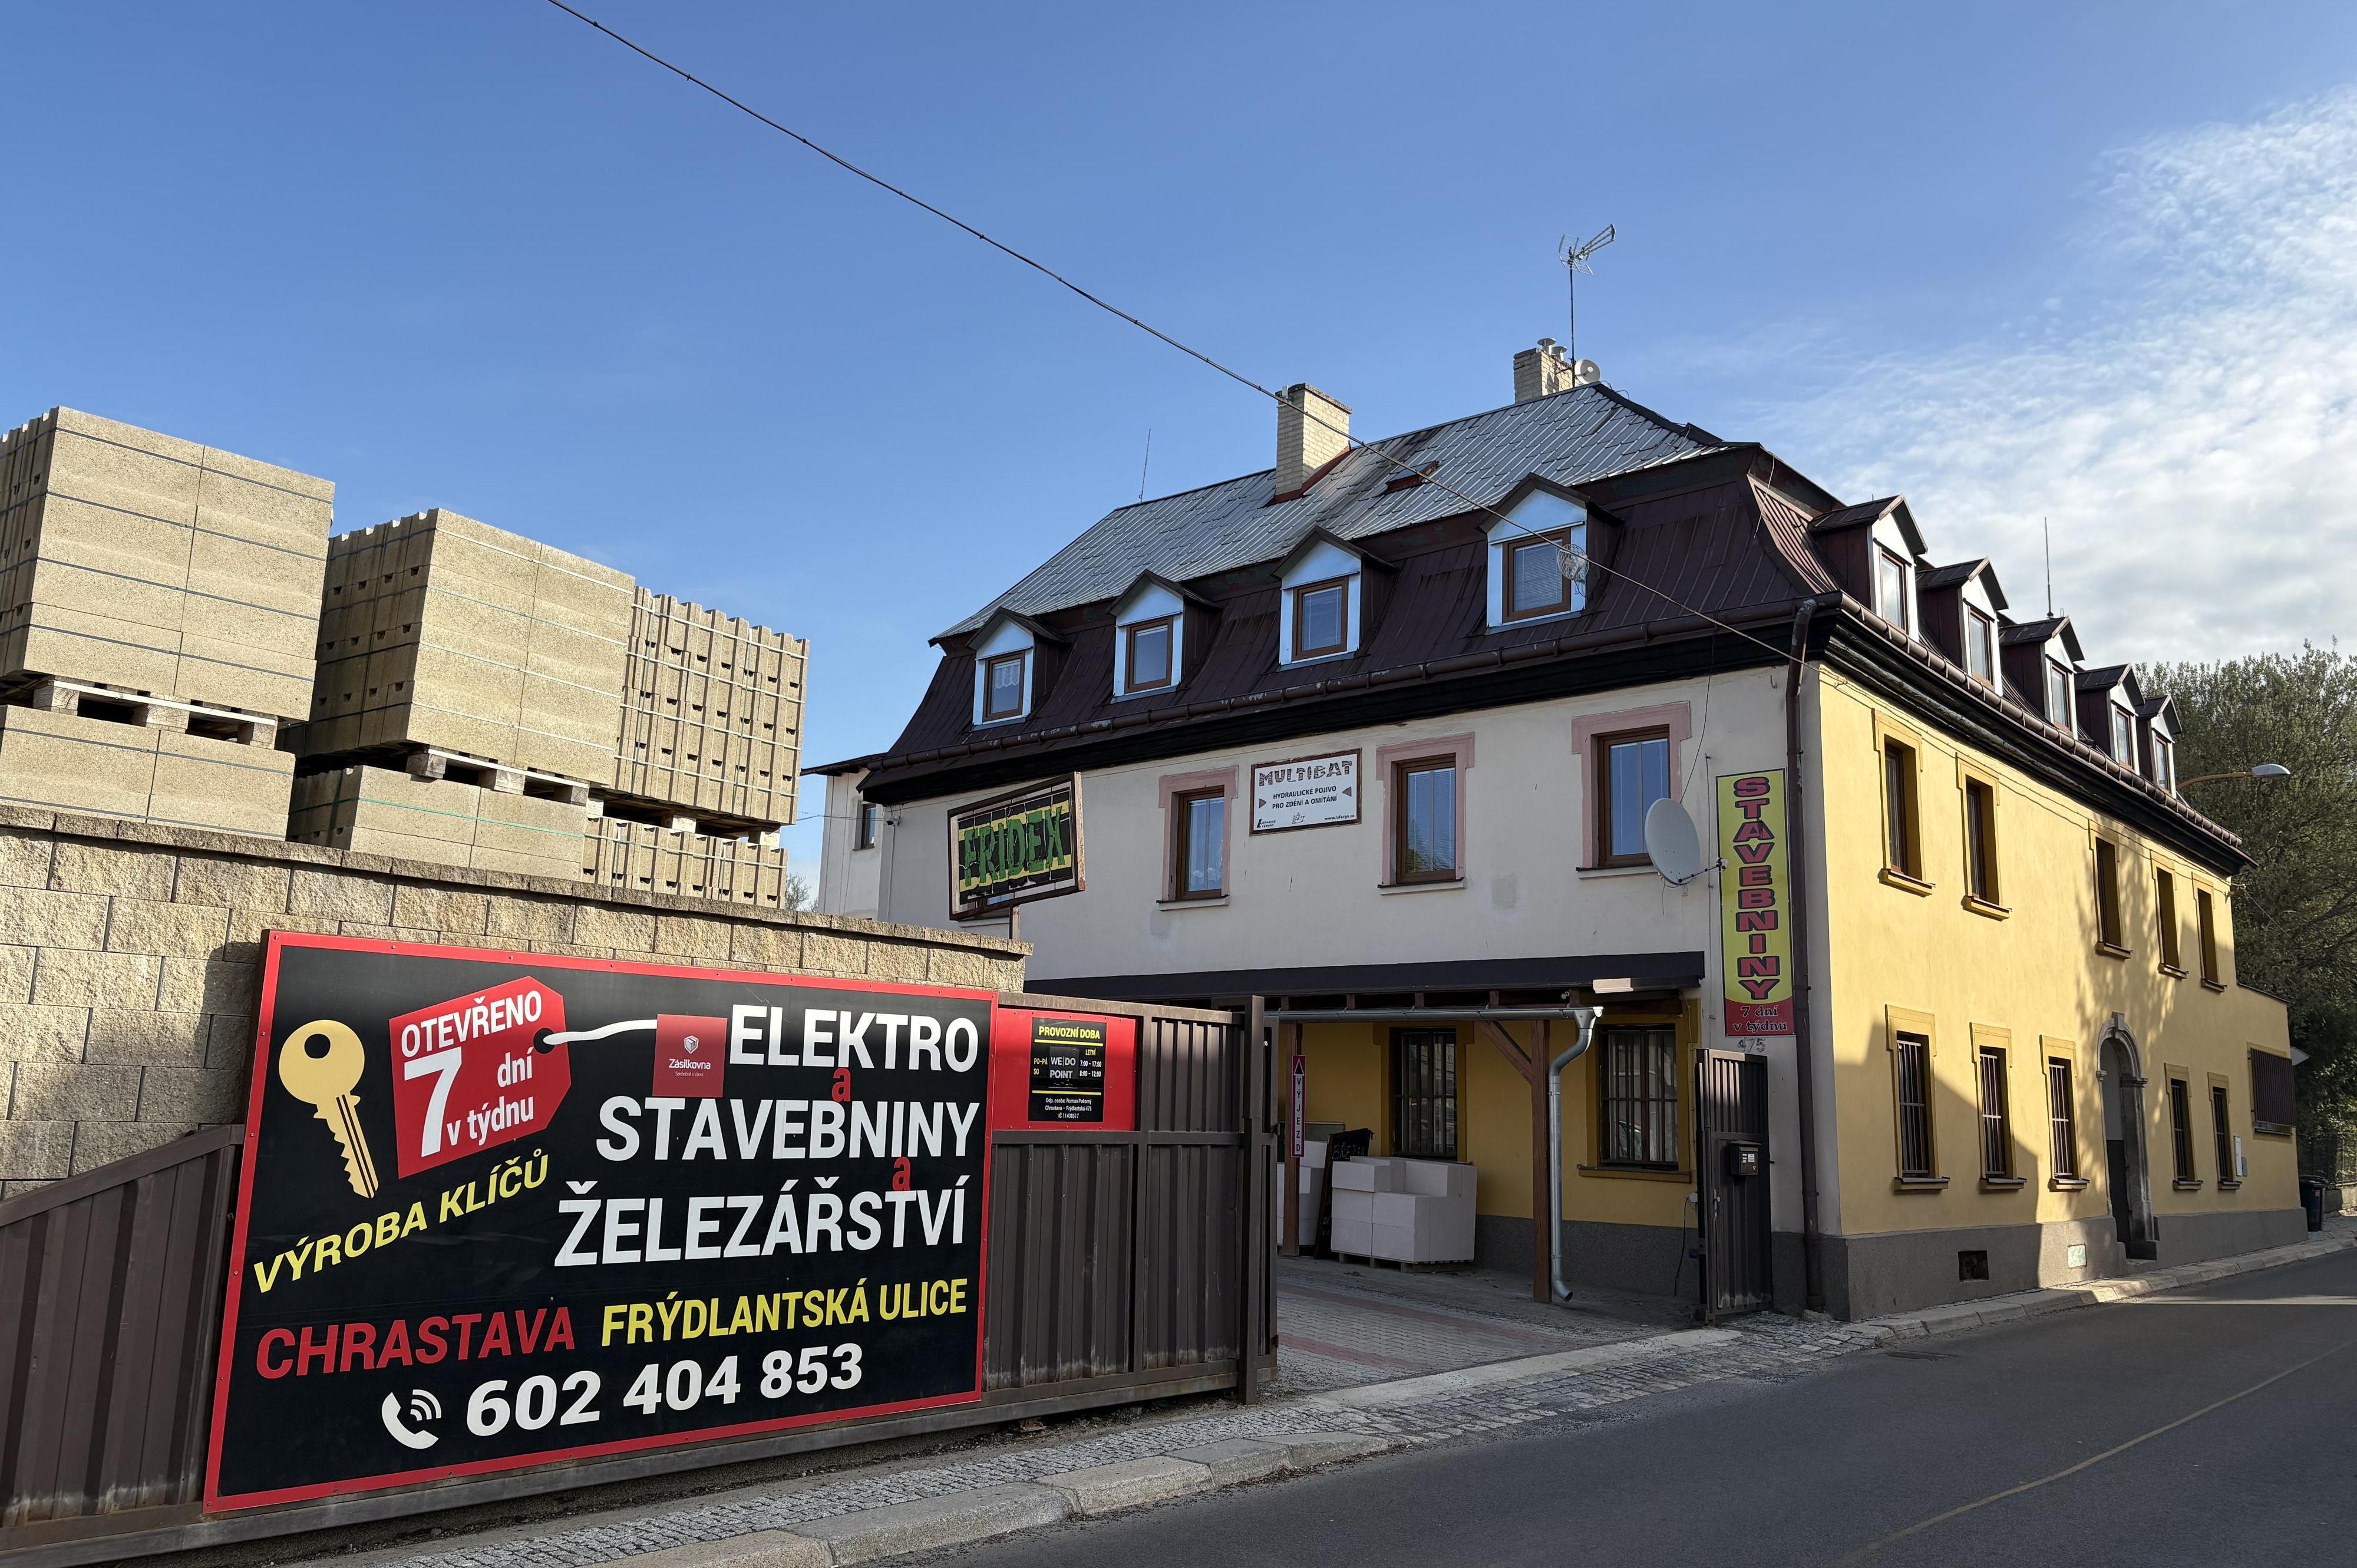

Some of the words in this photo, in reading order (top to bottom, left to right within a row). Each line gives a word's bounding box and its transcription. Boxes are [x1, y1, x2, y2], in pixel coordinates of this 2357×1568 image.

[1259, 761, 1352, 787] MULTIBAT
[1273, 787, 1313, 799] HYDRAULICKÉ
[1315, 785, 1336, 794] POJIVO
[1286, 799, 1303, 807] ZDĚNÍ
[1310, 794, 1337, 804] OMÍTÁNÍ
[964, 807, 1066, 887] FRIDEX
[1733, 776, 1780, 1000] STAVEBNINY
[401, 990, 542, 1058] OTEVŘENO
[1039, 1026, 1079, 1038] PROVOZNÍ
[1080, 1029, 1100, 1039] DOBA
[1732, 1023, 1742, 1031] v
[1746, 1019, 1787, 1033] týdnu
[1740, 1006, 1751, 1017] 7
[1754, 1005, 1778, 1016] dní
[669, 1058, 711, 1069] Zásilkovna
[729, 1004, 978, 1072] ELEKTRO
[831, 1068, 851, 1102] a
[1049, 1069, 1073, 1078] POINT
[404, 1046, 462, 1158] 7
[497, 1046, 534, 1088] dní
[447, 1120, 461, 1146] v
[467, 1095, 534, 1146] týdnu
[596, 1095, 980, 1161] STAVEBNINY
[892, 1156, 910, 1191] a
[253, 1201, 427, 1293] VÝROBA
[439, 1148, 548, 1223] KLÍČŮ
[554, 1175, 971, 1267] ŽELEZÁŘSTVÍ
[256, 1306, 575, 1379] CHRASTAVA
[602, 1277, 870, 1346] FRÝDLANTSKÁ
[879, 1277, 968, 1321] ULICE
[467, 1371, 601, 1437] 602
[623, 1356, 741, 1415] 404
[760, 1343, 863, 1399] 853
